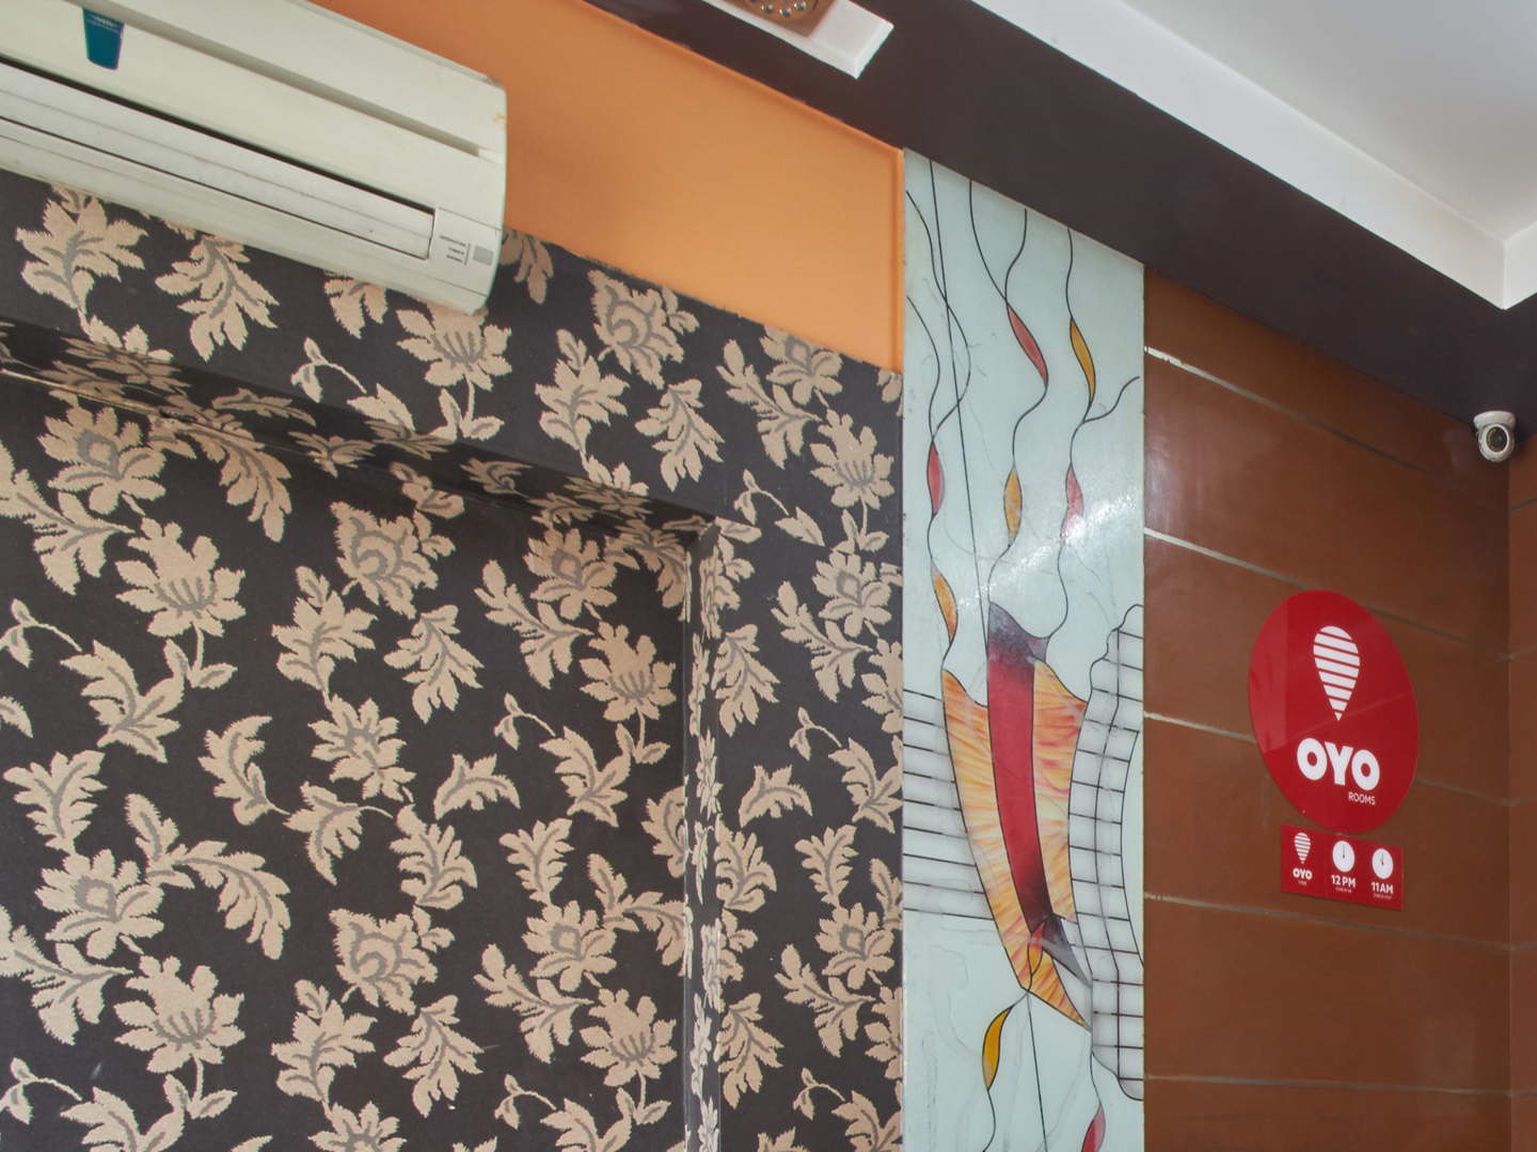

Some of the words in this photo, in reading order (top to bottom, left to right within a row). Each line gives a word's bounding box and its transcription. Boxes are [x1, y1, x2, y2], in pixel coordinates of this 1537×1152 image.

[1296, 737, 1380, 791] OYO
[1348, 791, 1376, 806] ROOMS
[1292, 867, 1313, 881] OYO
